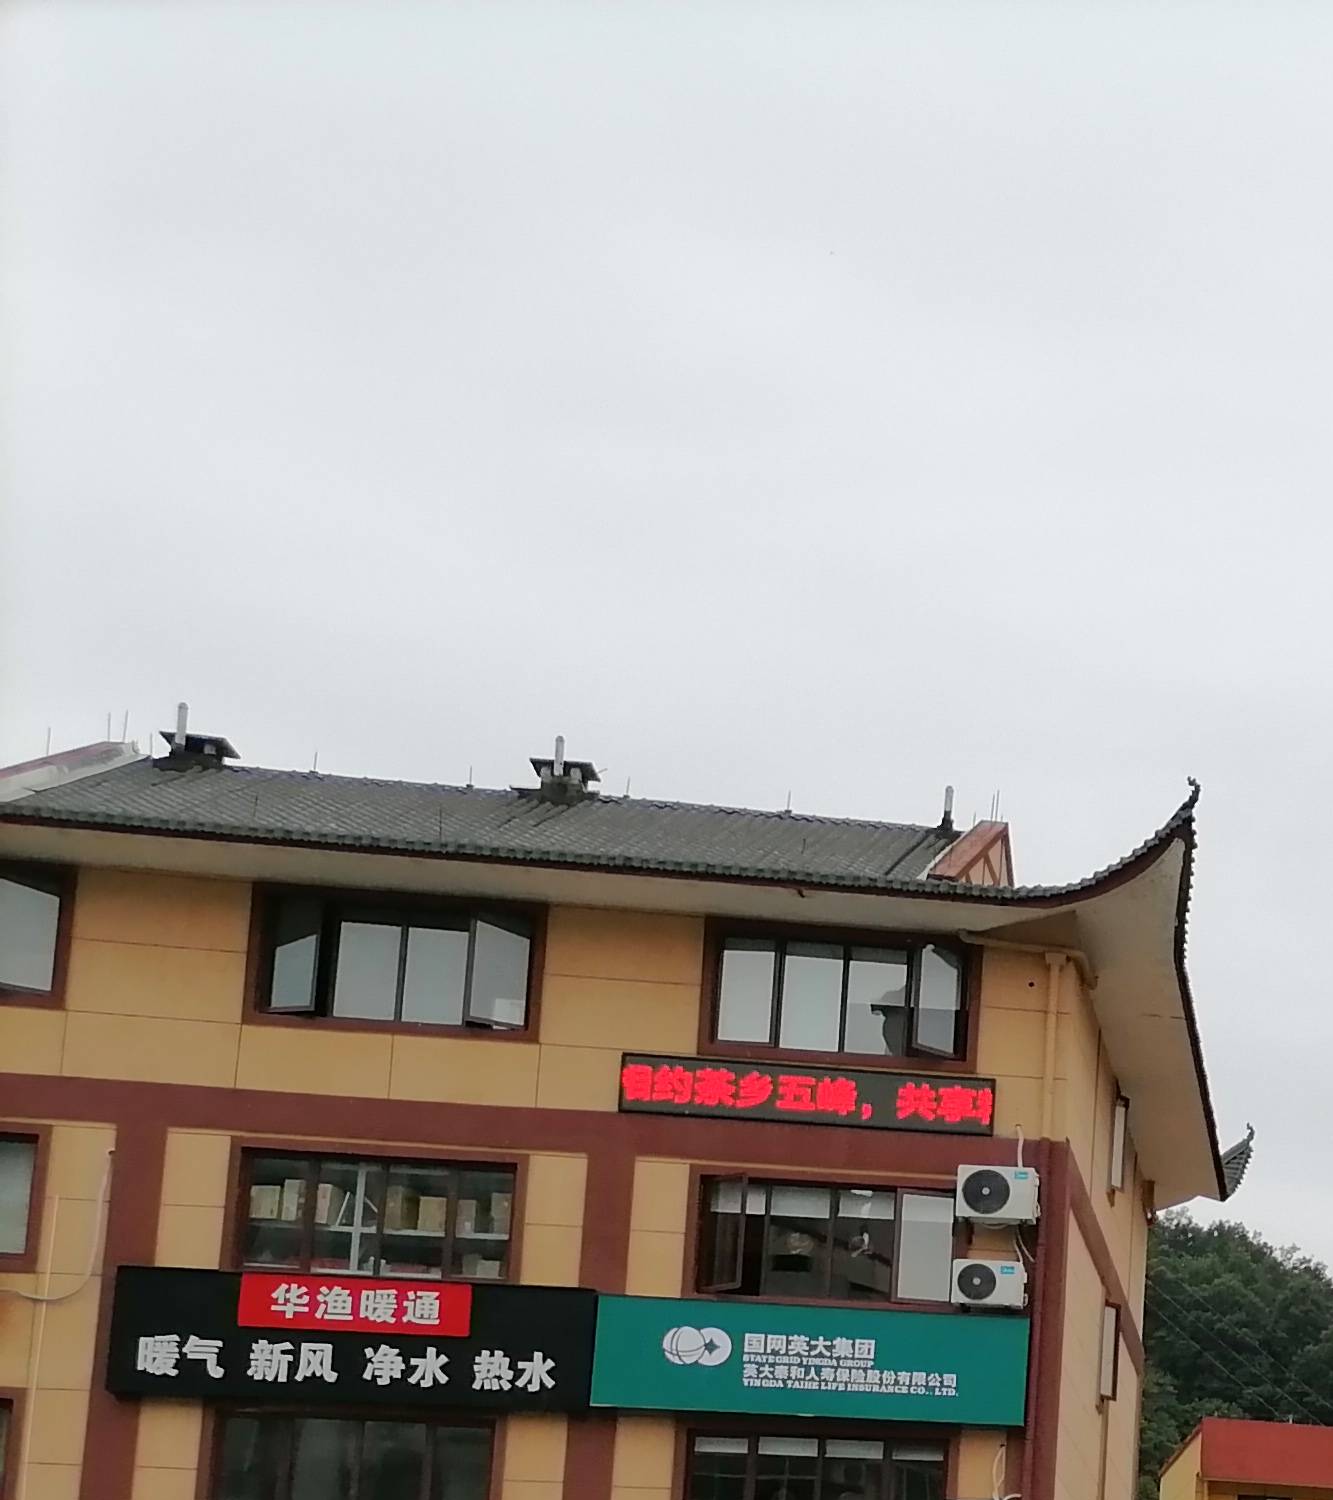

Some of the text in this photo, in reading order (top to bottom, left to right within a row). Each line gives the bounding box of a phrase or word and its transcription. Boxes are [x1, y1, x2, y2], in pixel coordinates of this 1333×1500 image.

[270, 1282, 441, 1324] 华渔暖通
[743, 1333, 875, 1359] 国网英大集团
[137, 1335, 556, 1392] 暖气 新风 净水 热水
[743, 1364, 957, 1388] 英大泰和人寿保险股份有限公司
[840, 1359, 874, 1368] GROUP
[743, 1378, 784, 1388] YINGDA
[821, 1382, 845, 1391] LIFE
[847, 1384, 908, 1394] INSURANCE
[935, 1388, 959, 1397] LTD.
